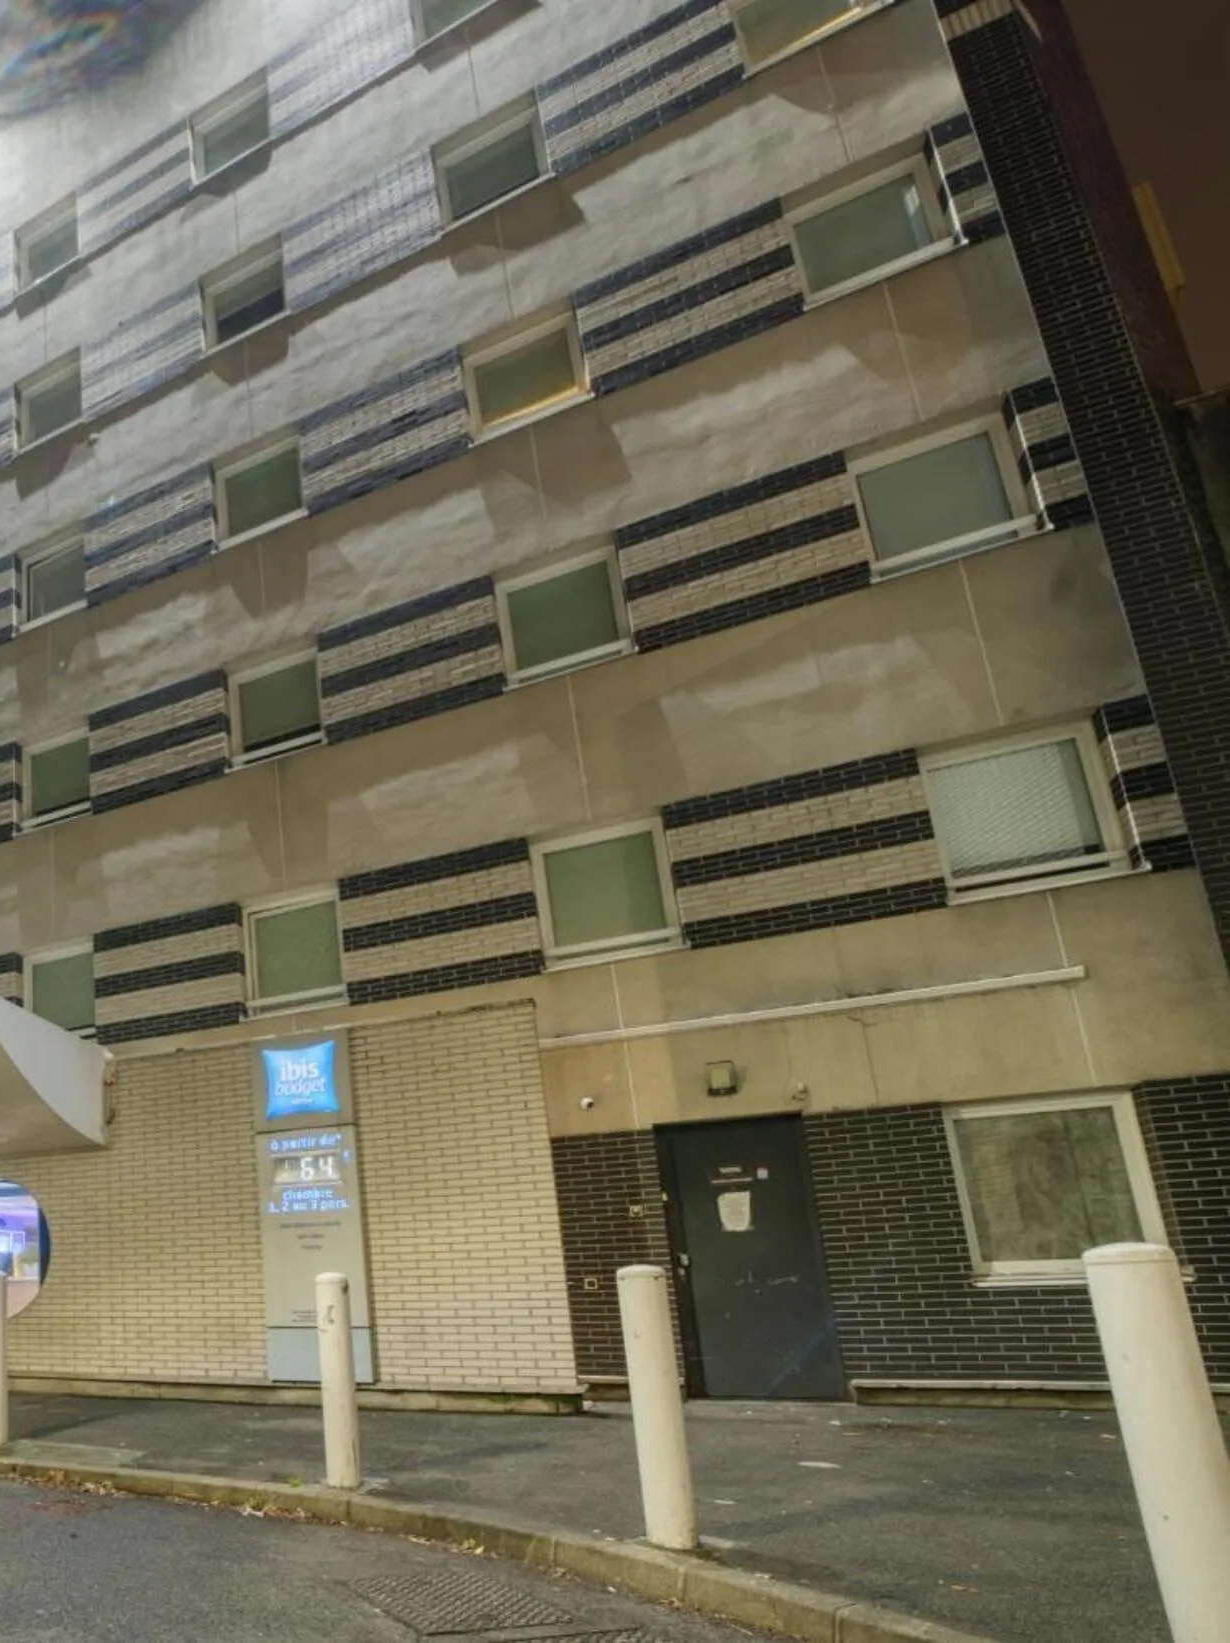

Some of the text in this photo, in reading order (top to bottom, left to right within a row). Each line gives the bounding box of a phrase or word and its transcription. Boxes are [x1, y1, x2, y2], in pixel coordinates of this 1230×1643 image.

[280, 1058, 319, 1081] ibis
[275, 1077, 326, 1097] budget
[300, 1156, 333, 1180] 64
